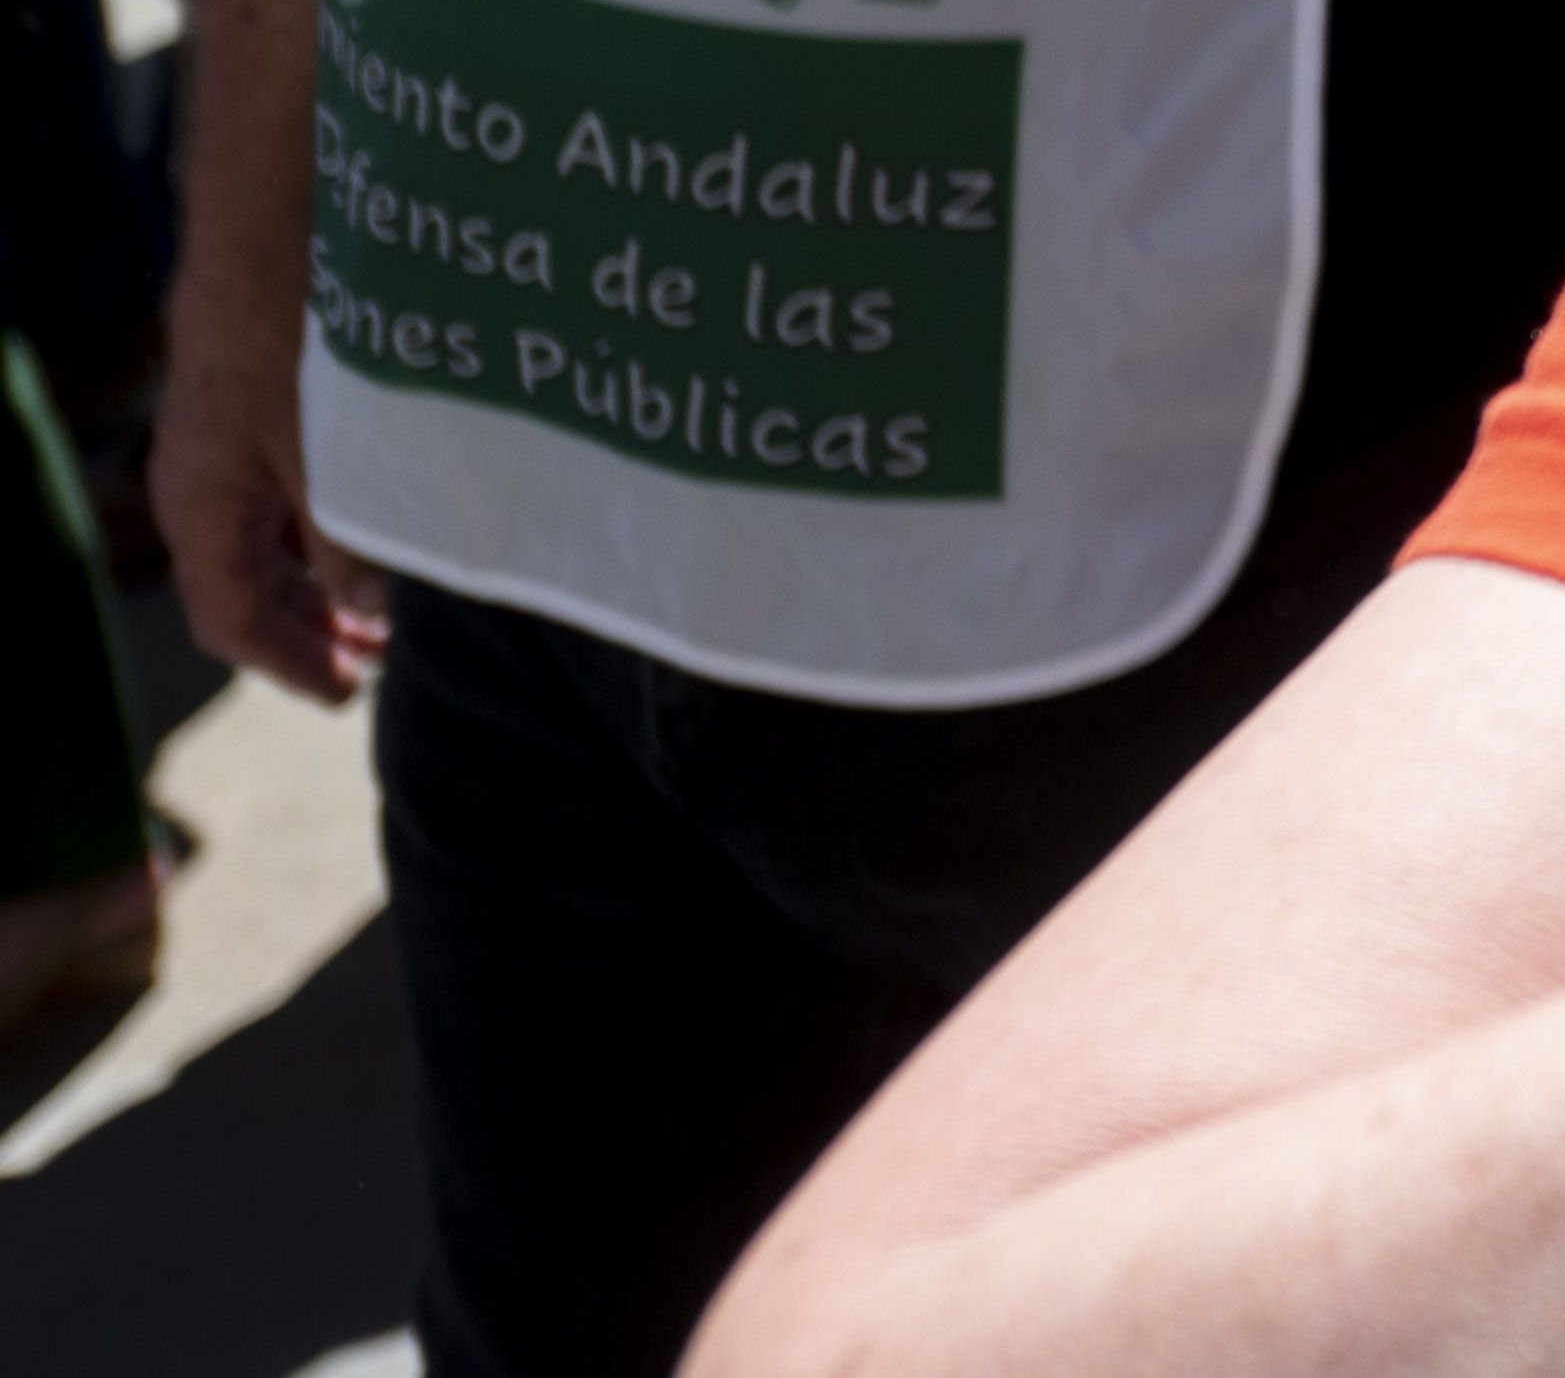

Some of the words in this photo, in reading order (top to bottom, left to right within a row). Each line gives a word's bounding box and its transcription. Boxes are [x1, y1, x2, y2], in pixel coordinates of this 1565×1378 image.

[557, 111, 996, 229] Andaluz
[592, 238, 698, 327] de
[746, 263, 895, 351] las
[516, 328, 930, 477] Públicas
